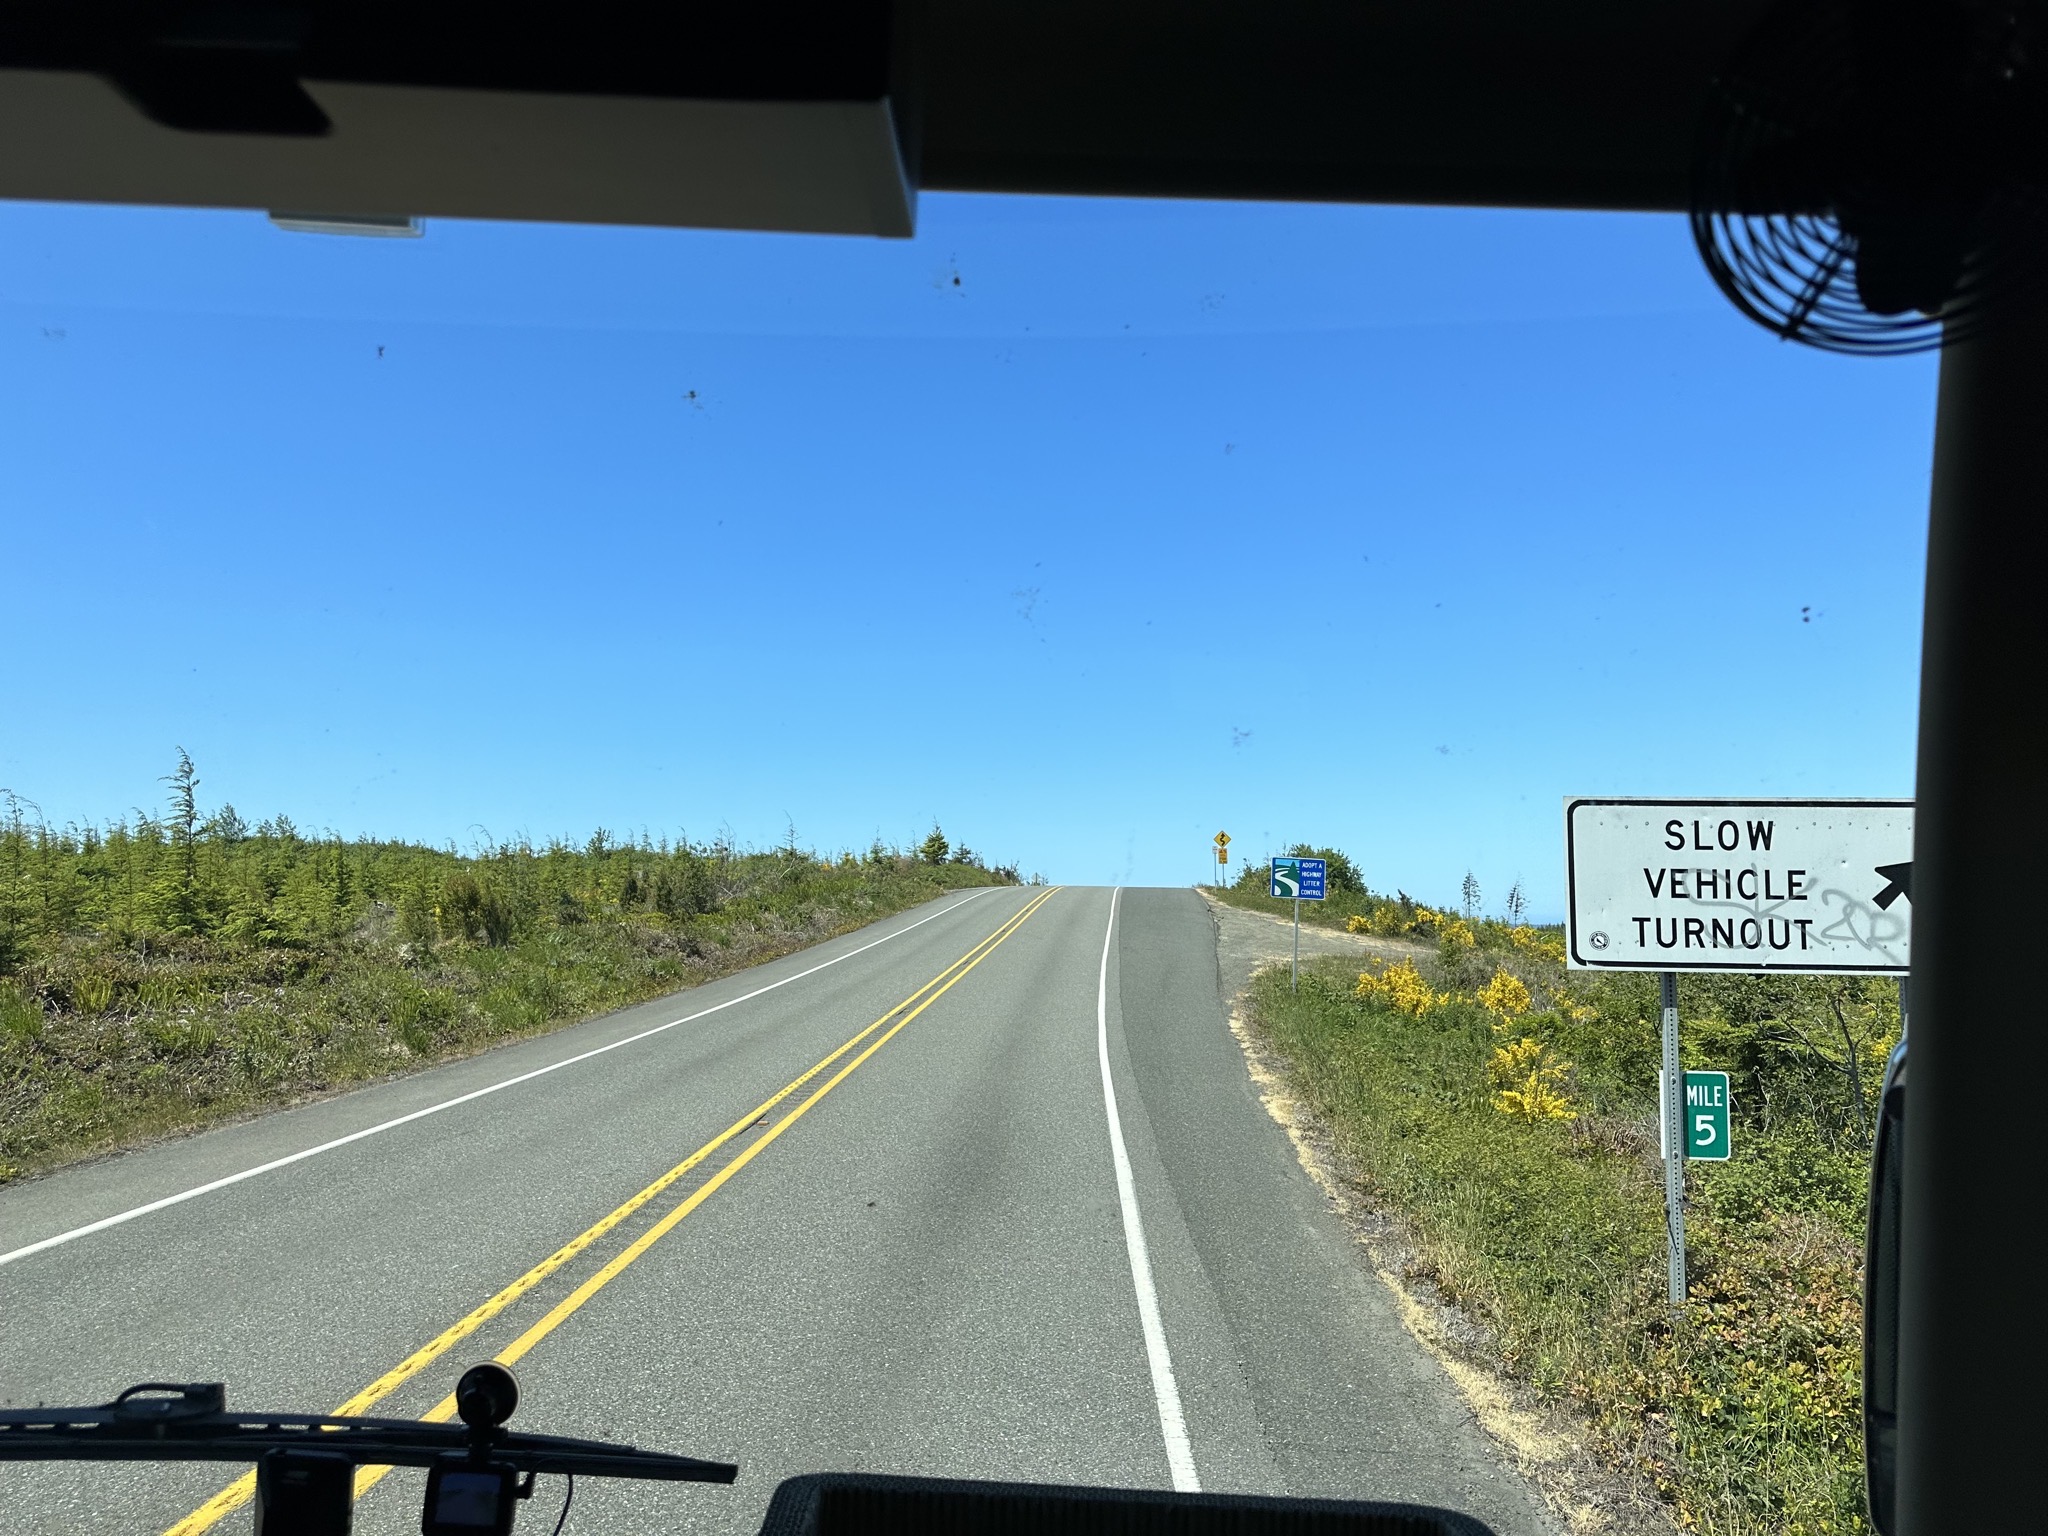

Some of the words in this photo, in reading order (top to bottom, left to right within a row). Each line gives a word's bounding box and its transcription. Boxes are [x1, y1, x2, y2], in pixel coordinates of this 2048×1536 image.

[1664, 819, 1774, 851] SLOW
[1643, 867, 1808, 901] VEHICLE
[1632, 916, 1813, 951] TURNOUT
[1686, 1085, 1723, 1107] MILE
[1695, 1114, 1716, 1146] 5
